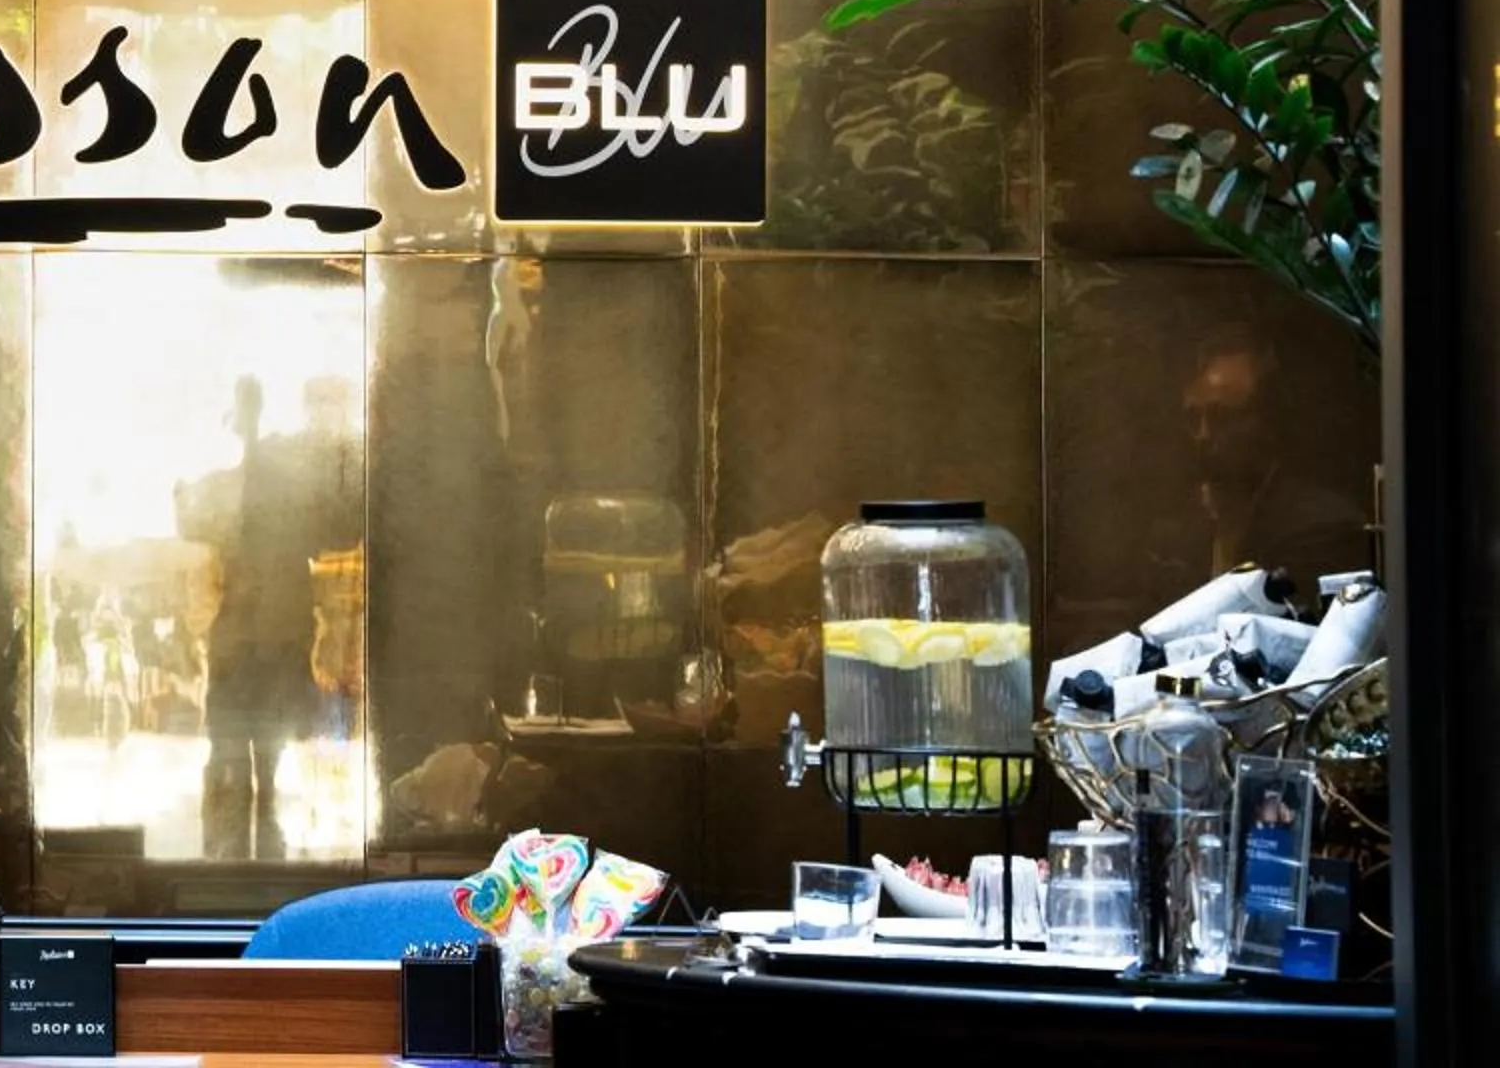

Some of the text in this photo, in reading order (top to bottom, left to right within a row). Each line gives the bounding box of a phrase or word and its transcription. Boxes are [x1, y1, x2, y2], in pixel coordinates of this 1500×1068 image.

[515, 63, 747, 132] BLU
[9, 979, 36, 990] KEY
[31, 1023, 106, 1035] DROP BOX
